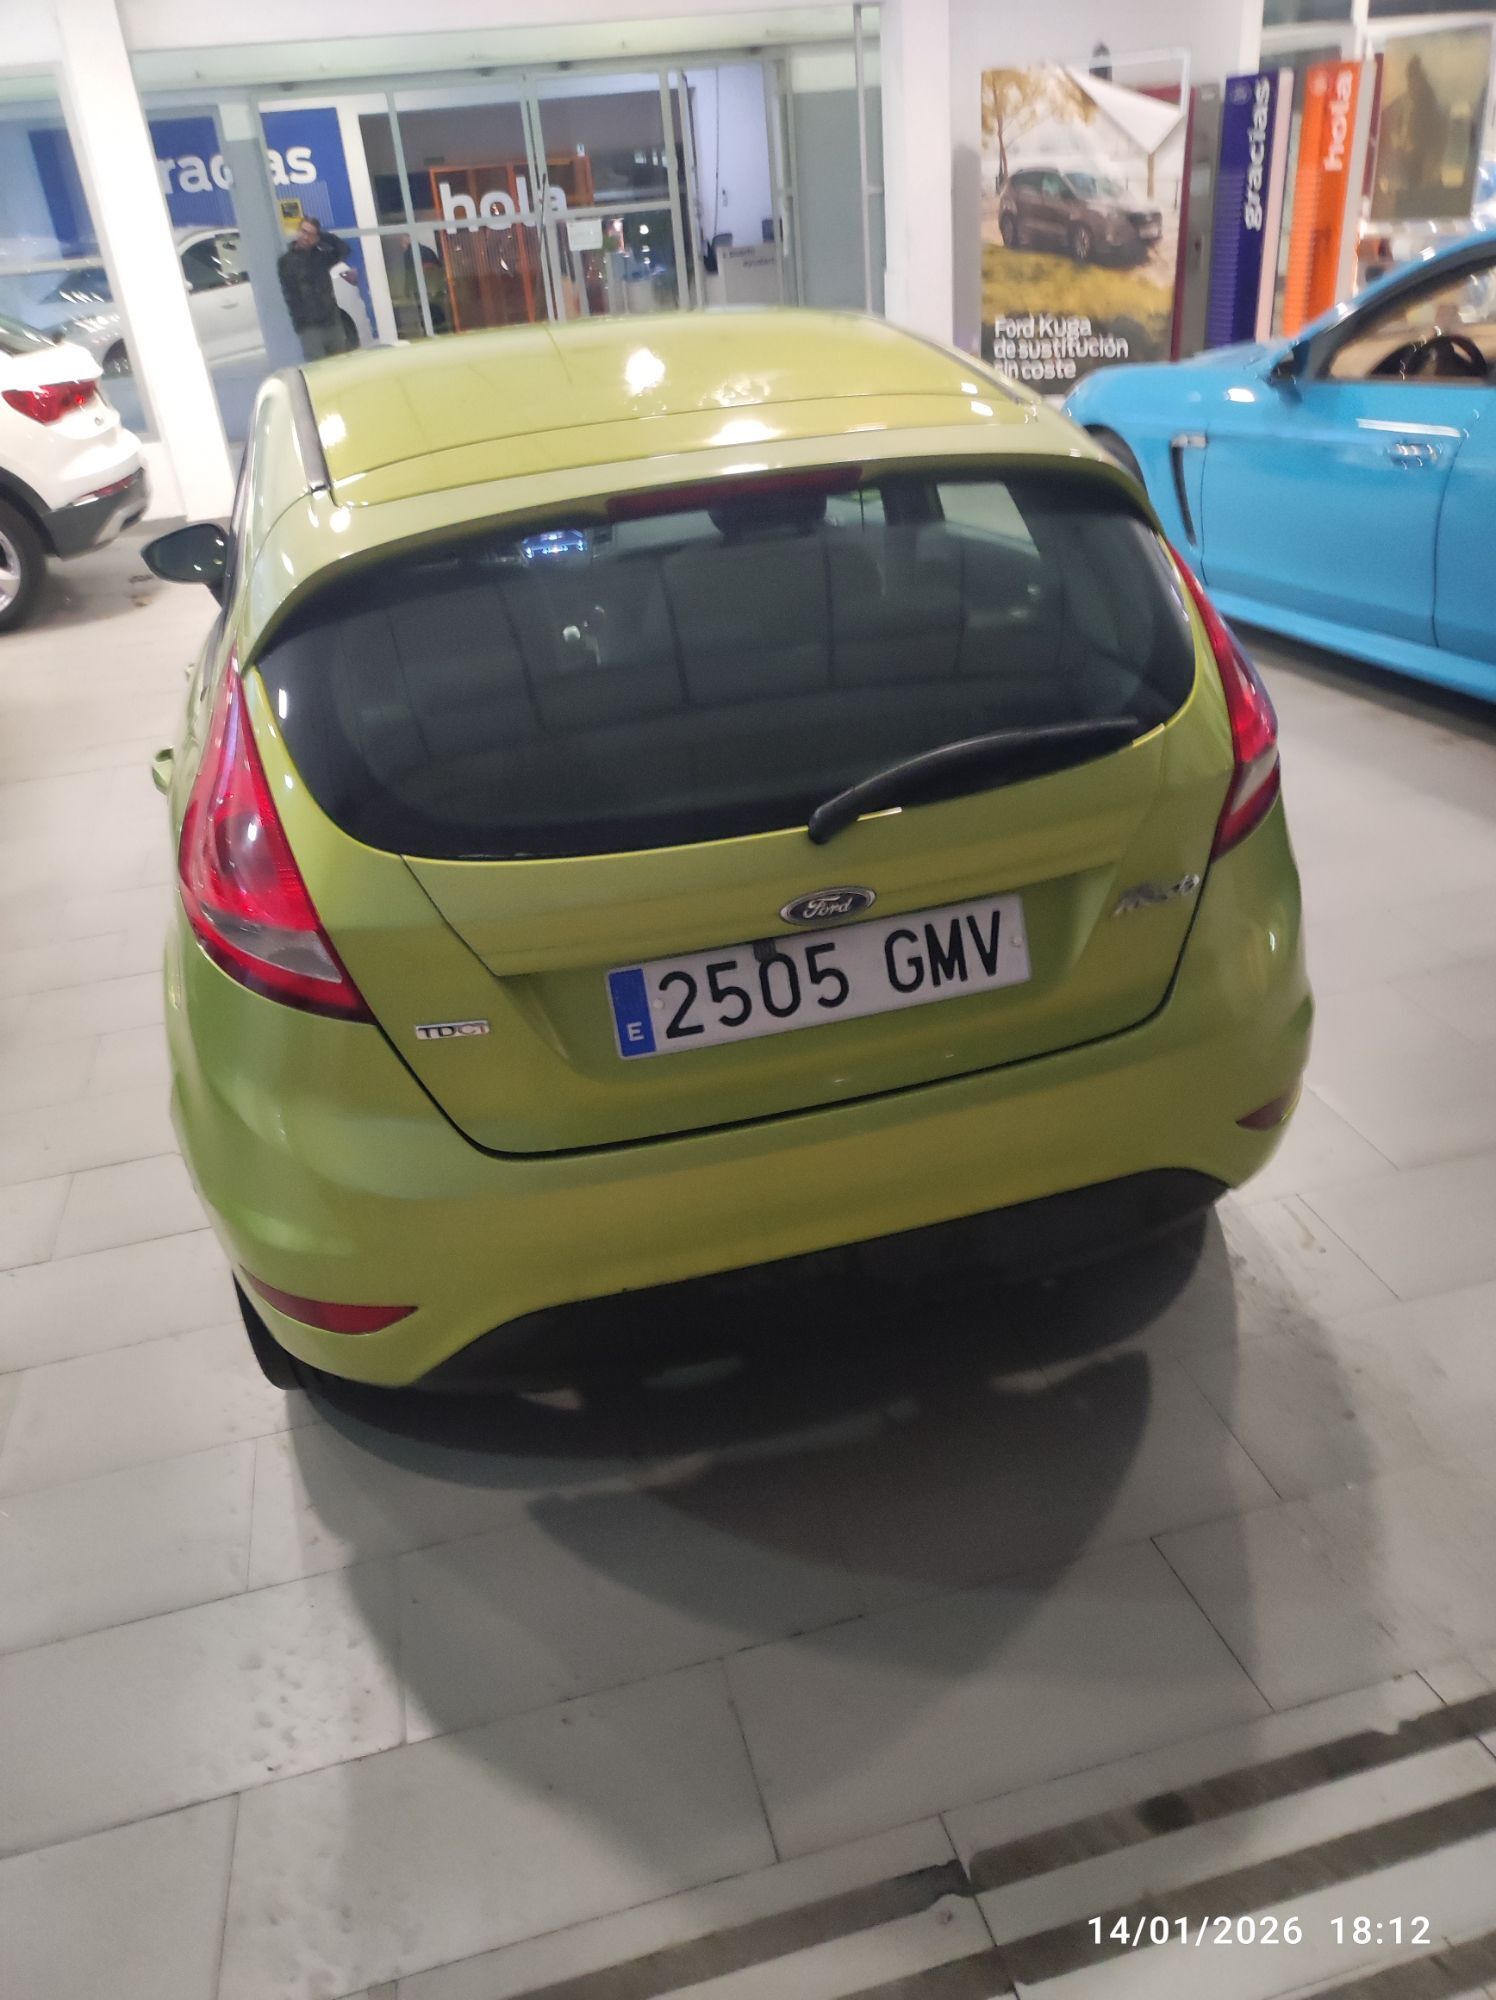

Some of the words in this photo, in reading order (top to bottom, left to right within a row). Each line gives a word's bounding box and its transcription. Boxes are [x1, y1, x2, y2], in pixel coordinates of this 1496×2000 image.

[1323, 69, 1353, 171] hola
[1244, 76, 1270, 231] gracias
[993, 335, 1016, 359] de
[994, 313, 1035, 339] Ford
[1039, 313, 1092, 342] Kuga
[1020, 359, 1077, 380] coste
[627, 1022, 645, 1042] E
[658, 942, 850, 1040] 2505
[884, 910, 1001, 994] GMV
